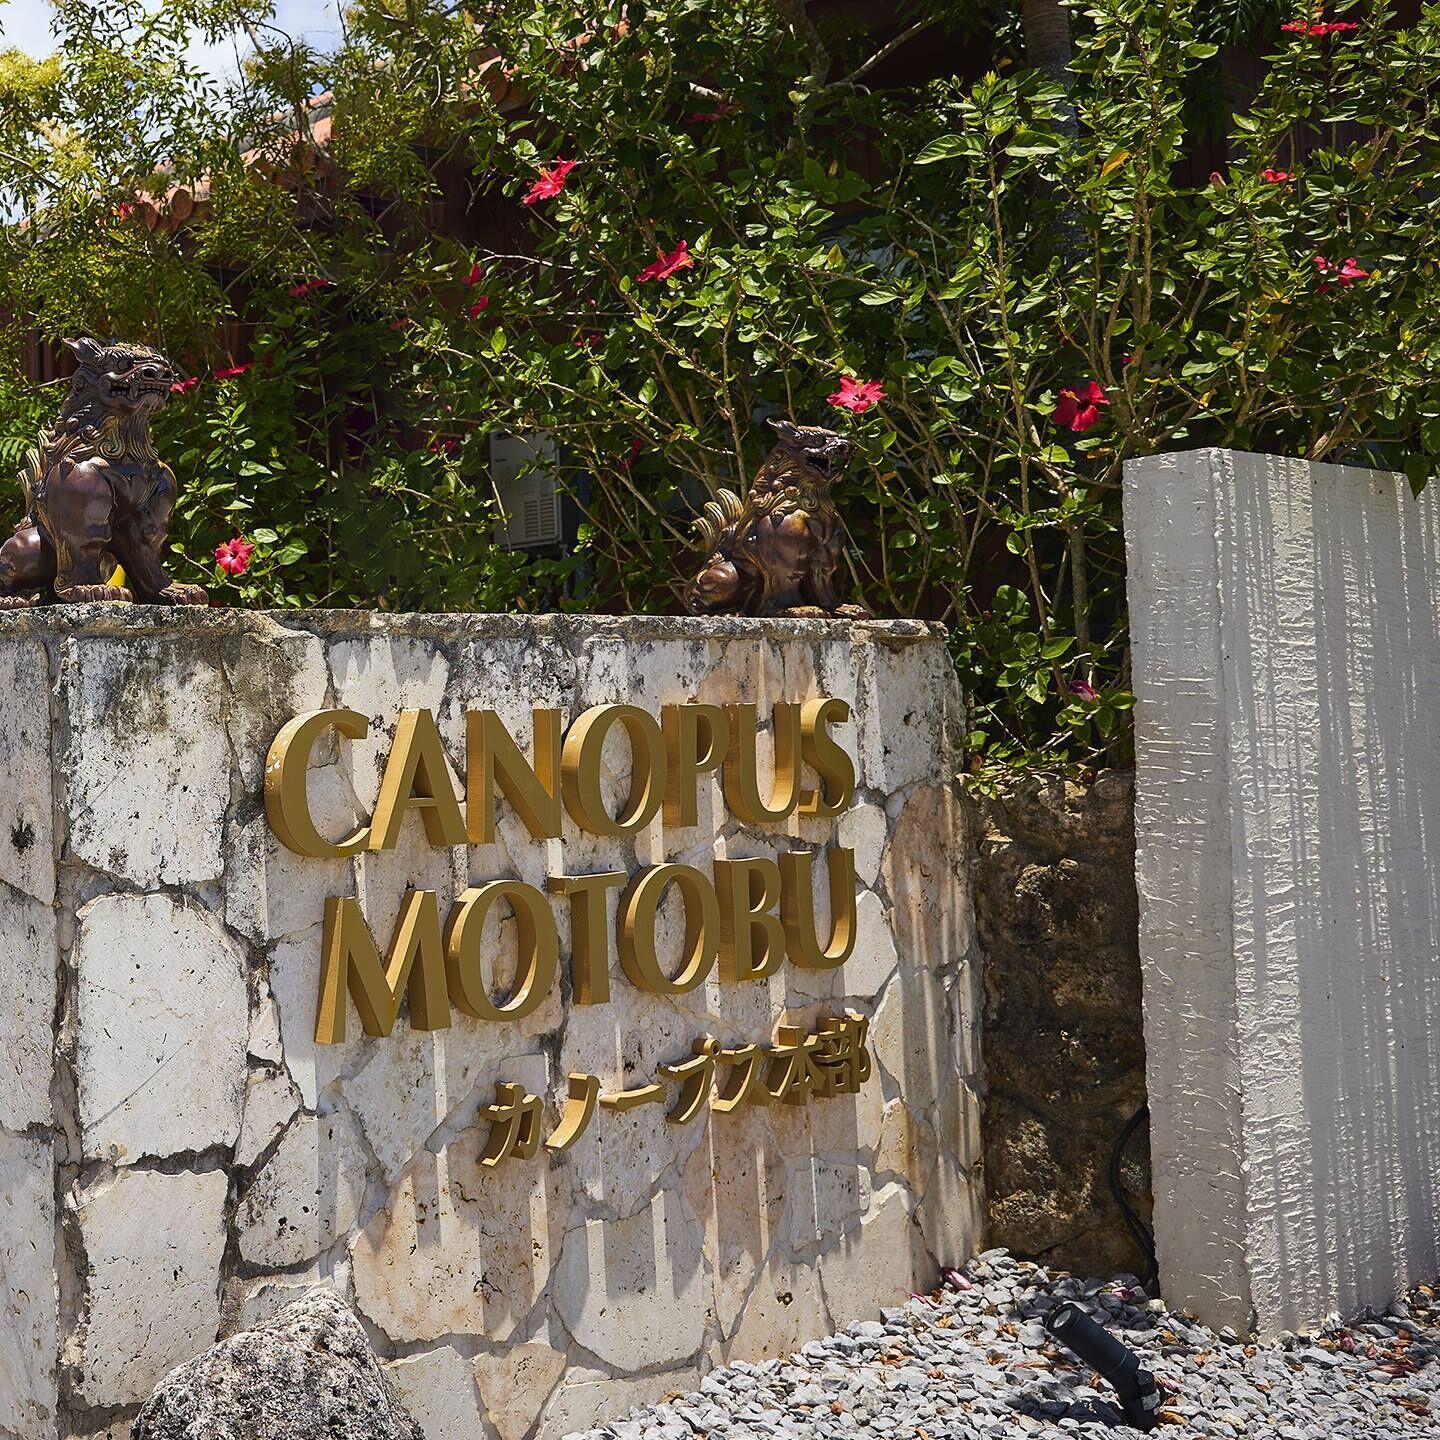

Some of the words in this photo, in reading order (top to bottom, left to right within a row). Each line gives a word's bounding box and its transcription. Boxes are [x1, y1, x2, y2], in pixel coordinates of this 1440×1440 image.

[265, 698, 855, 858] CANOPUS
[314, 847, 856, 1045] MOTOBU
[478, 1013, 871, 1168] カノープス本部
